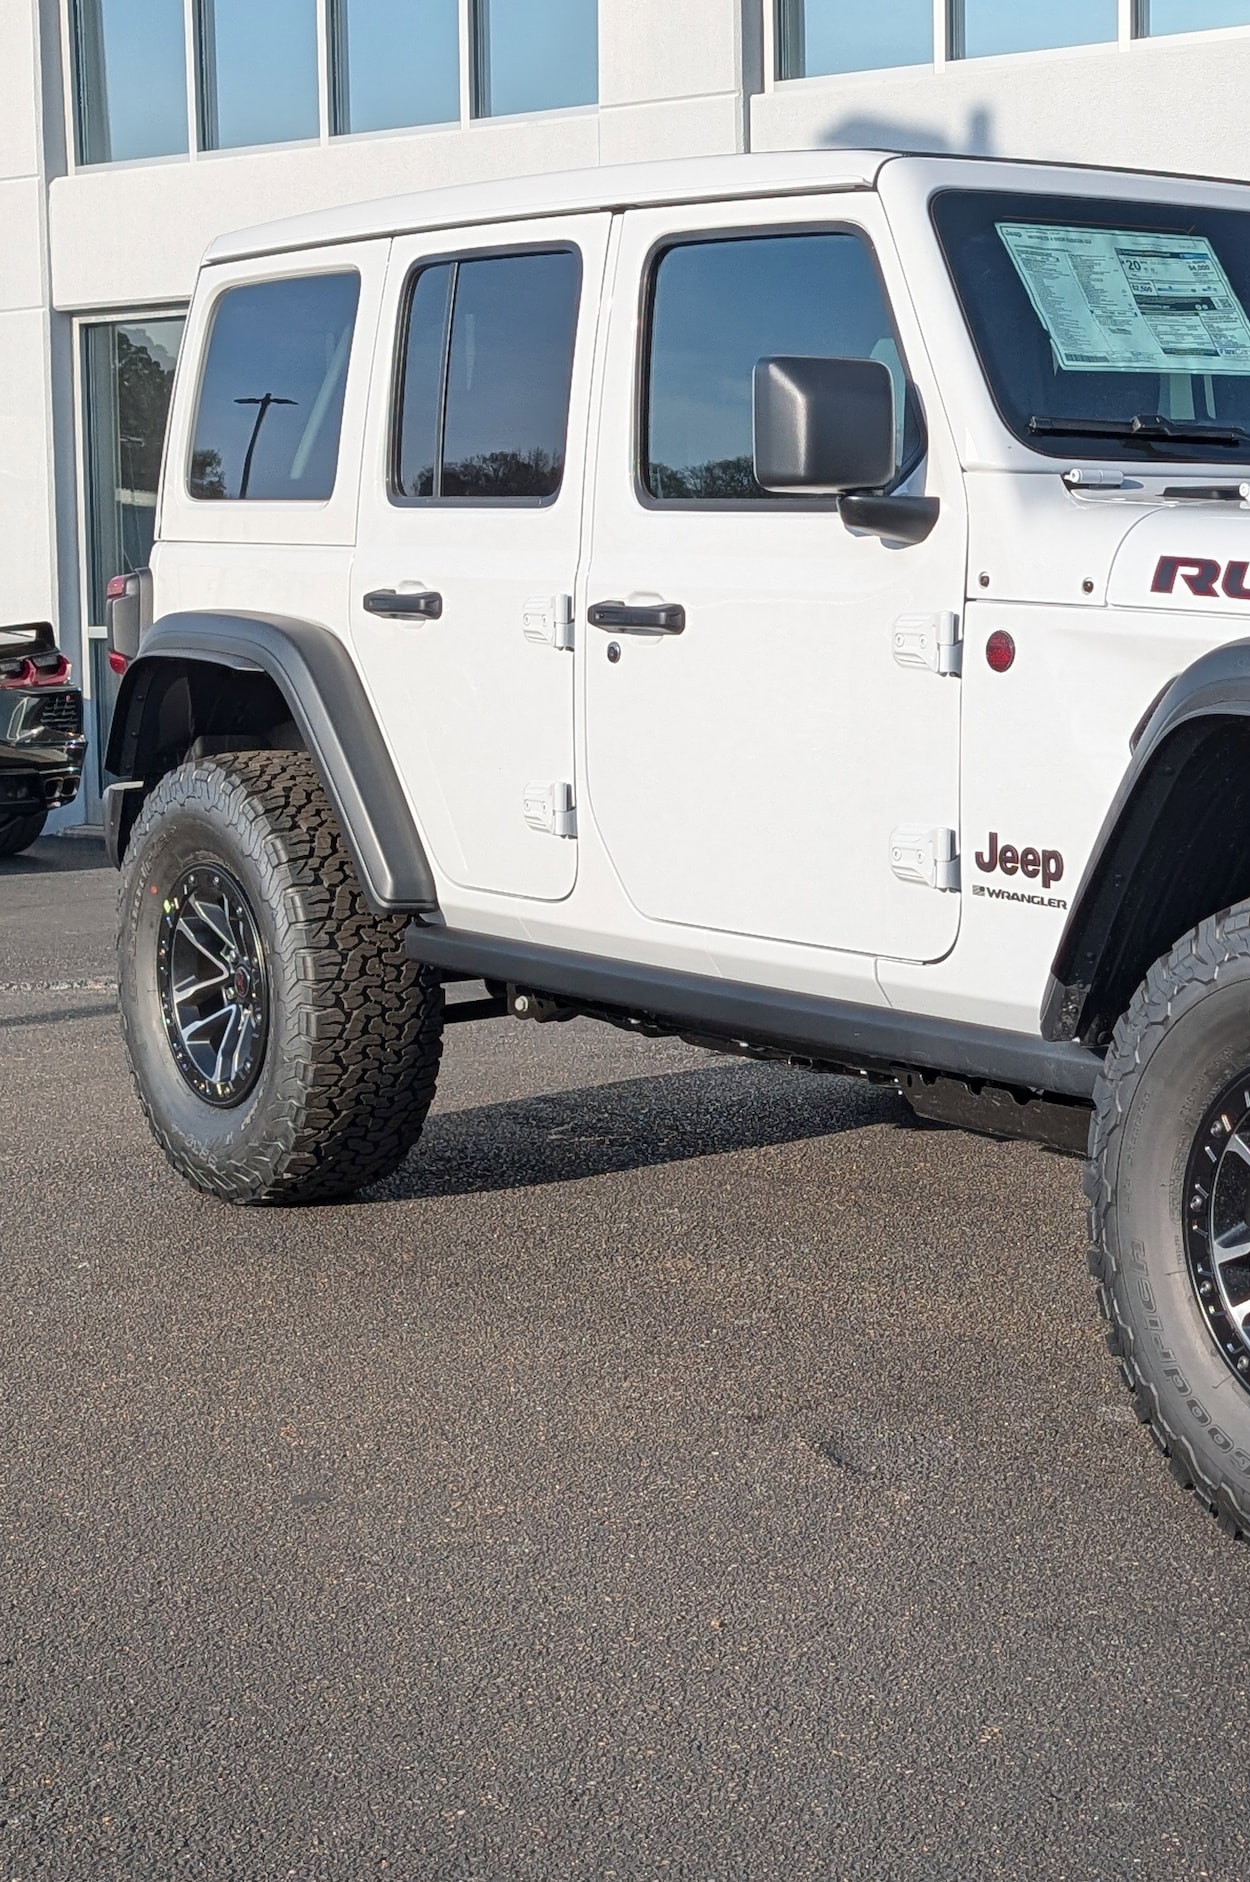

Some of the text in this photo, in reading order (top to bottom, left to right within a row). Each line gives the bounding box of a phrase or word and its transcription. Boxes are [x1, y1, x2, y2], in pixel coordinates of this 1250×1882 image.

[1126, 260, 1142, 271] 20
[975, 831, 1064, 889] Jeep
[986, 887, 1068, 910] WRANGLER
